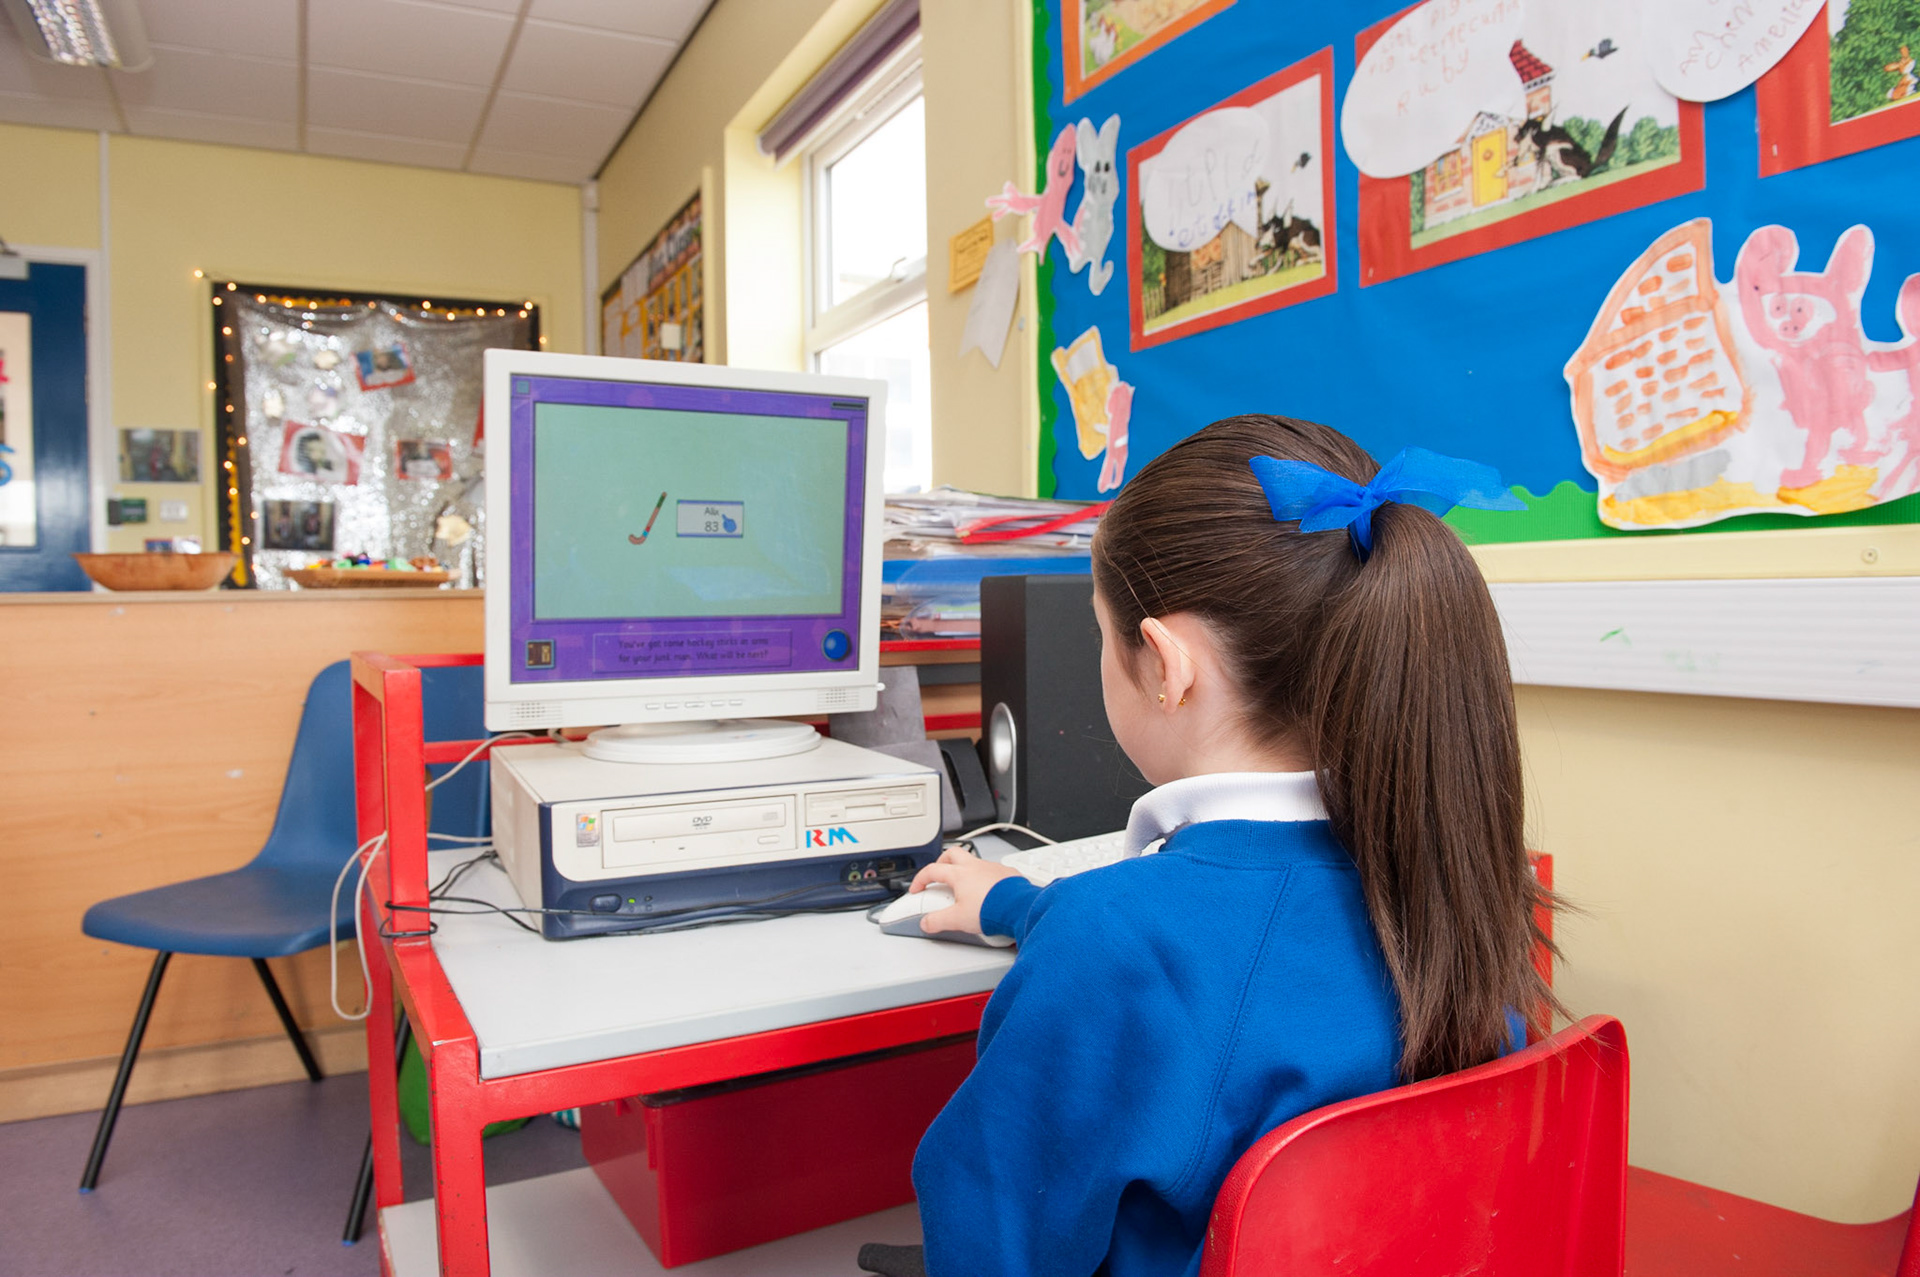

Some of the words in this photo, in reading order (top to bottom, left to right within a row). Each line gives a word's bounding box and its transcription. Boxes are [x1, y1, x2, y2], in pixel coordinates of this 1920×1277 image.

[704, 520, 719, 533] 83
[647, 640, 662, 652] got
[686, 638, 715, 650] hockey
[618, 653, 631, 663] for
[632, 653, 652, 666] your
[652, 651, 671, 665] junk
[692, 815, 713, 826] DVD
[805, 826, 860, 849] RM
